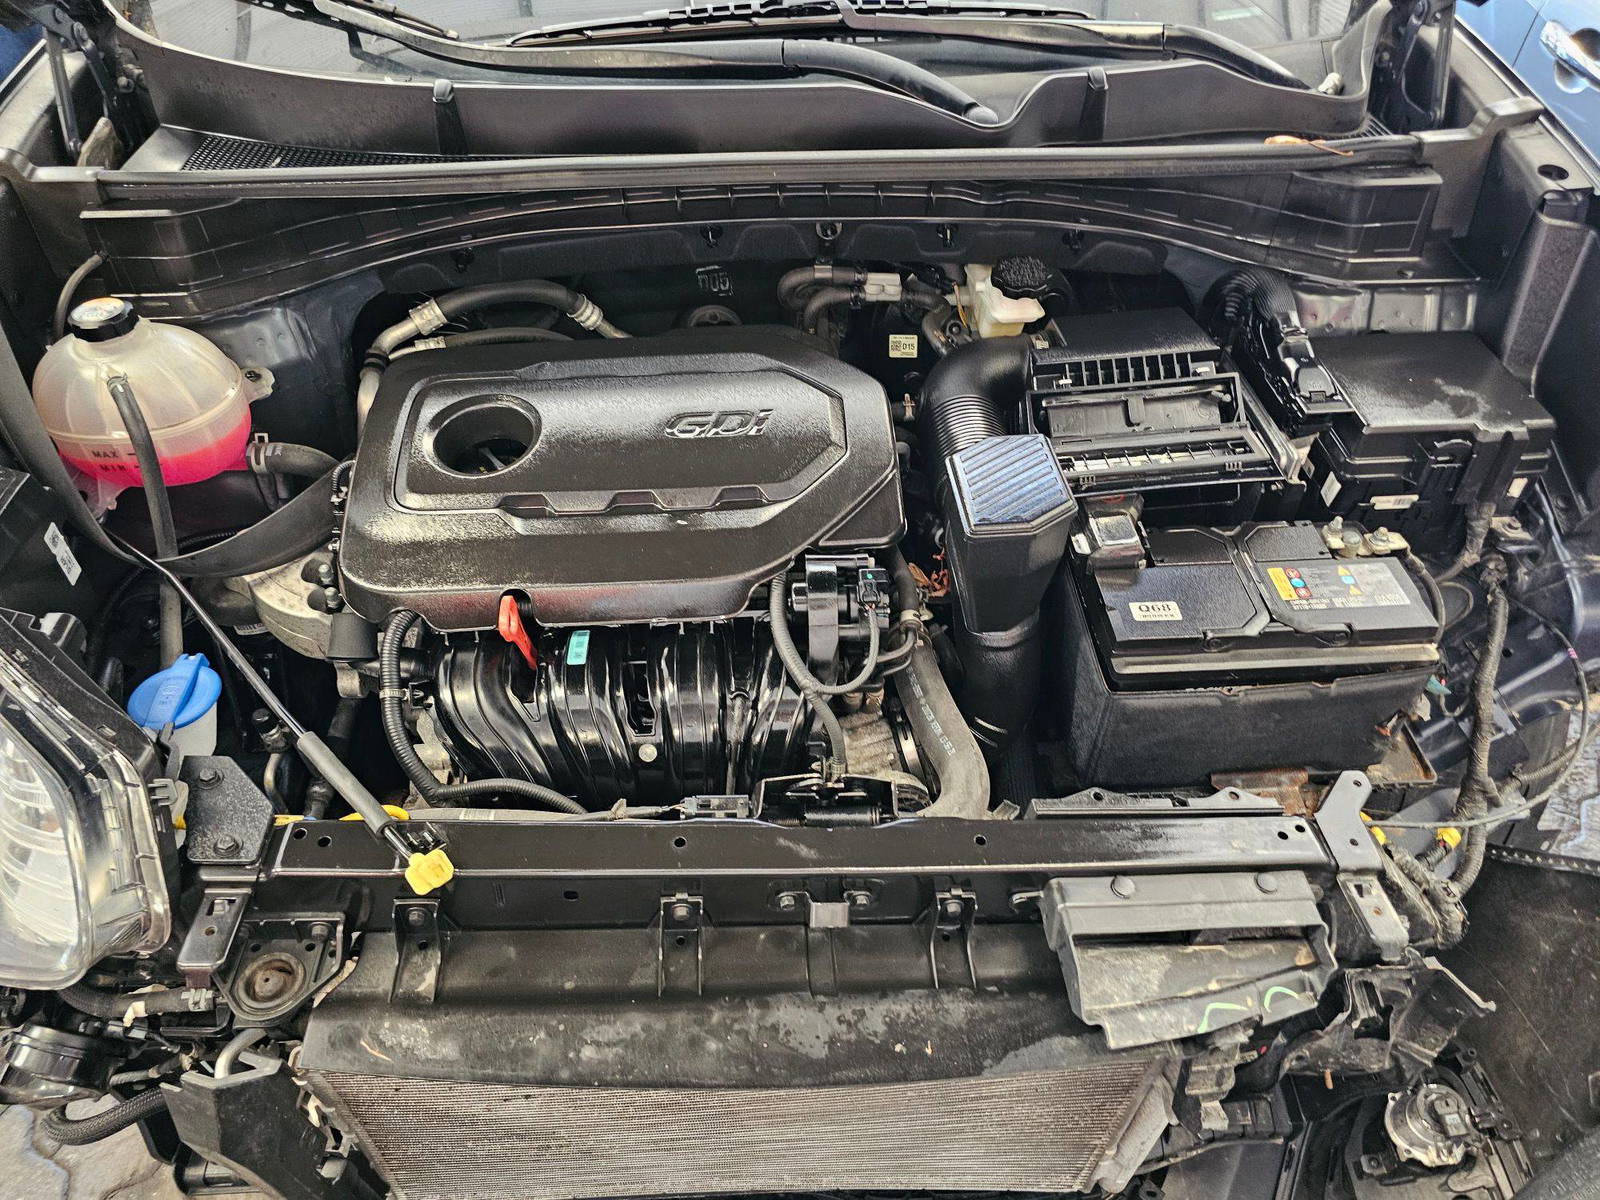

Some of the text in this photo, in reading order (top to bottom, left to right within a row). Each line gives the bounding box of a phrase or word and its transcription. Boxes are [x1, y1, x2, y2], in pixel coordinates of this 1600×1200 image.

[664, 408, 774, 439] GDi
[91, 450, 119, 458] MAX
[99, 463, 127, 472] MIN
[1138, 603, 1172, 613] Q68
